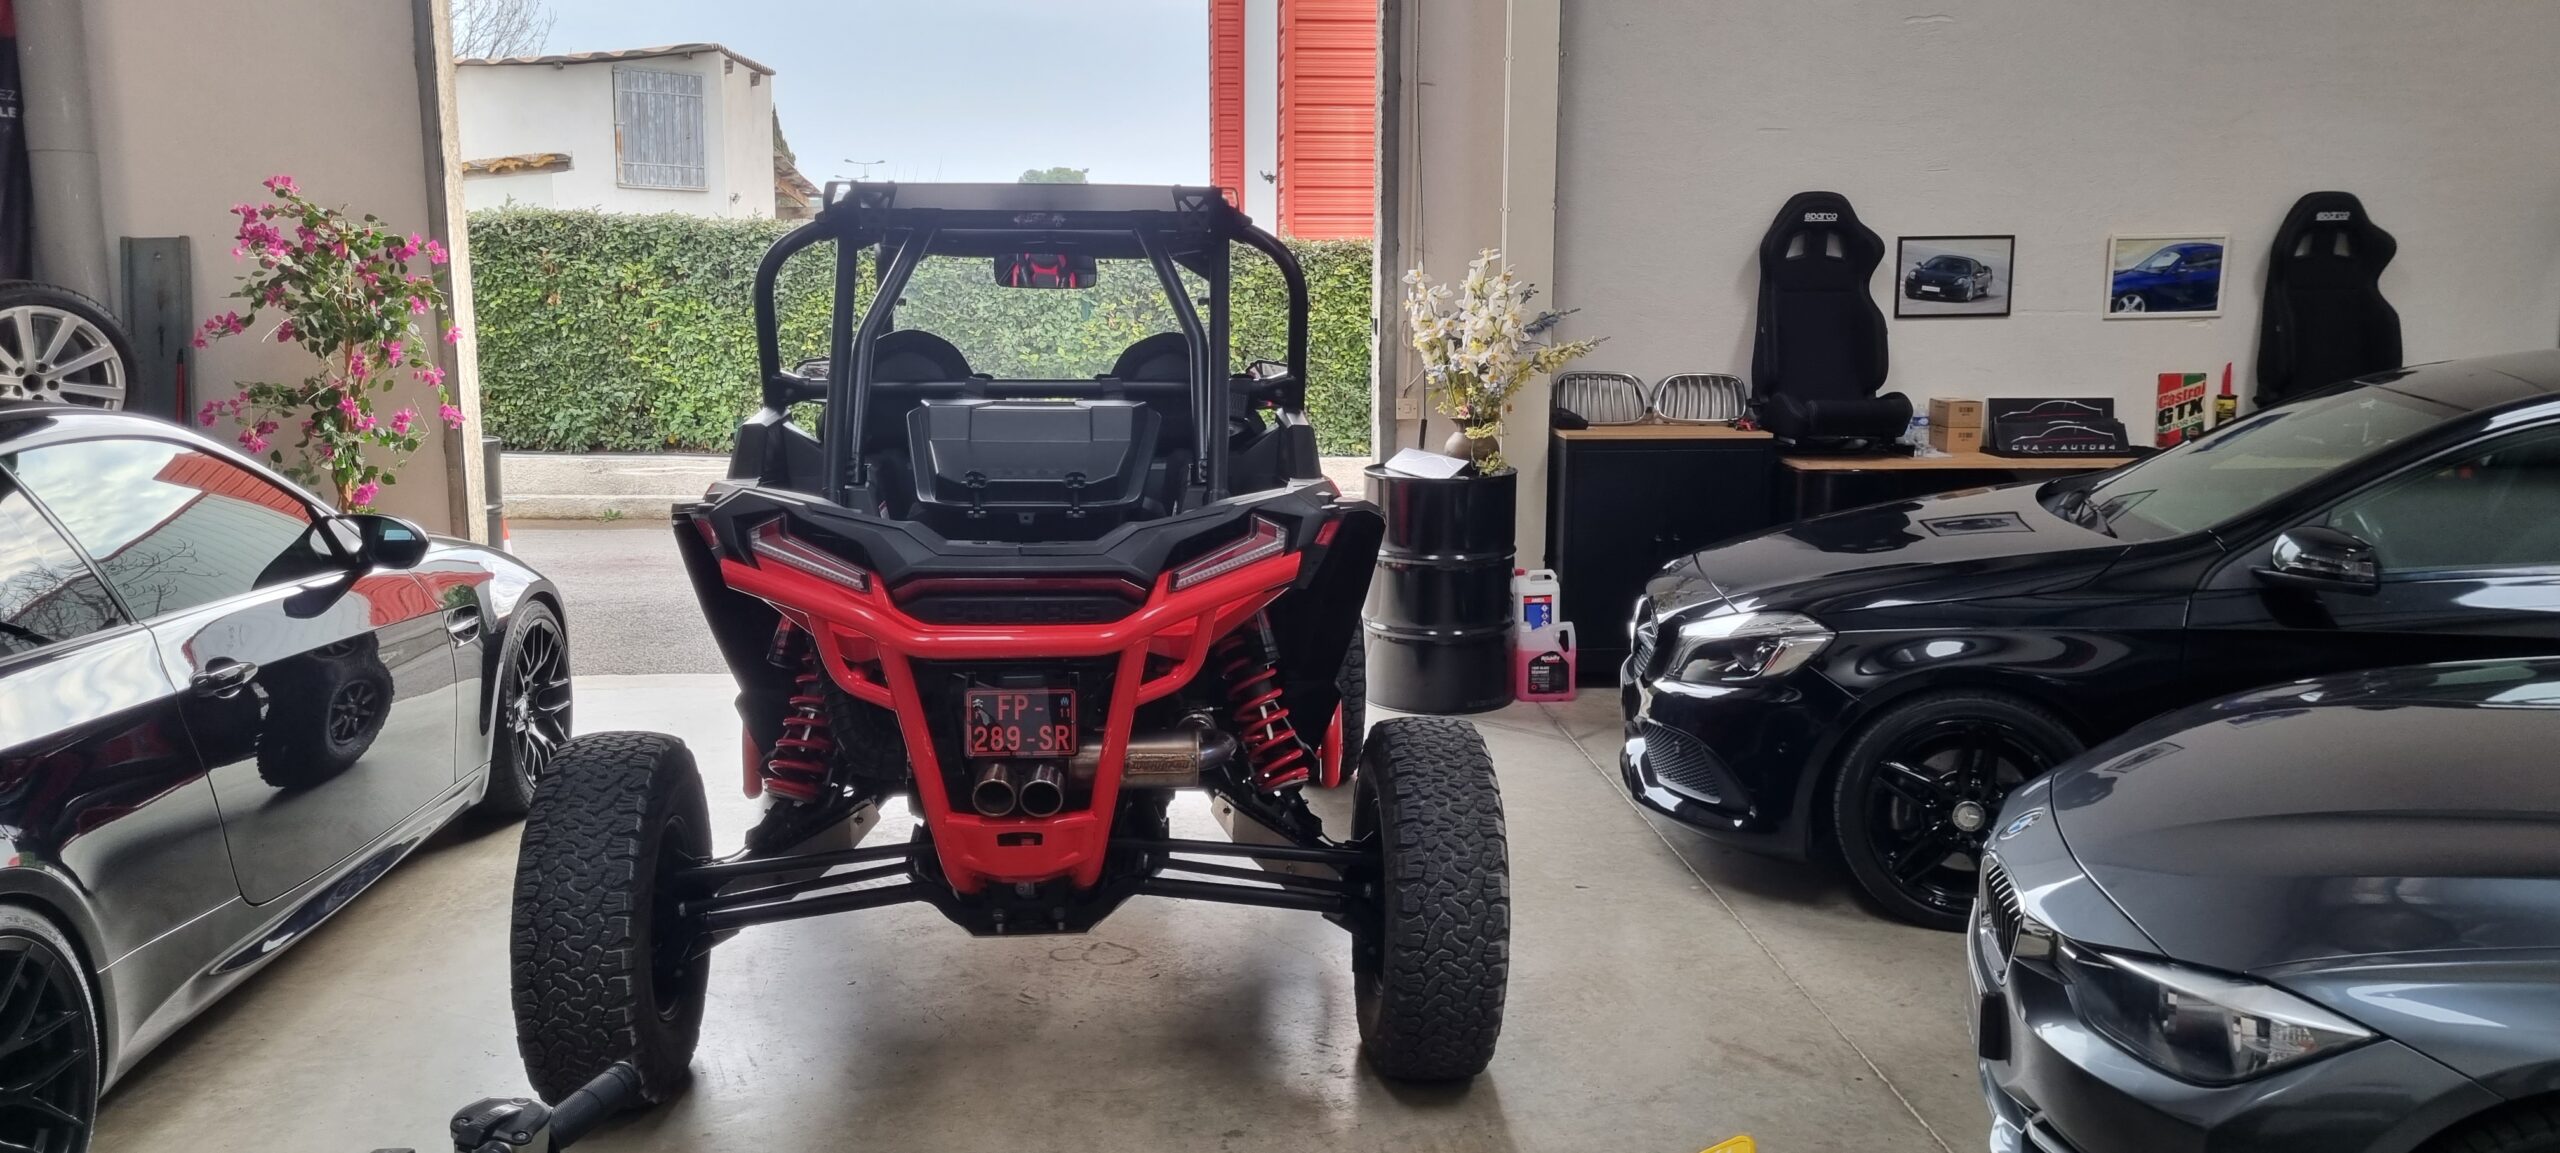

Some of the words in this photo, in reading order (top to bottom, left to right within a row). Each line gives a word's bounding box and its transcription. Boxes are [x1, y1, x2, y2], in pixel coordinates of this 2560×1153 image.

[2158, 381, 2206, 410] Castrol
[2158, 396, 2204, 427] GTX
[2011, 444, 2039, 452] CVA
[974, 725, 1071, 752] 289-SR
